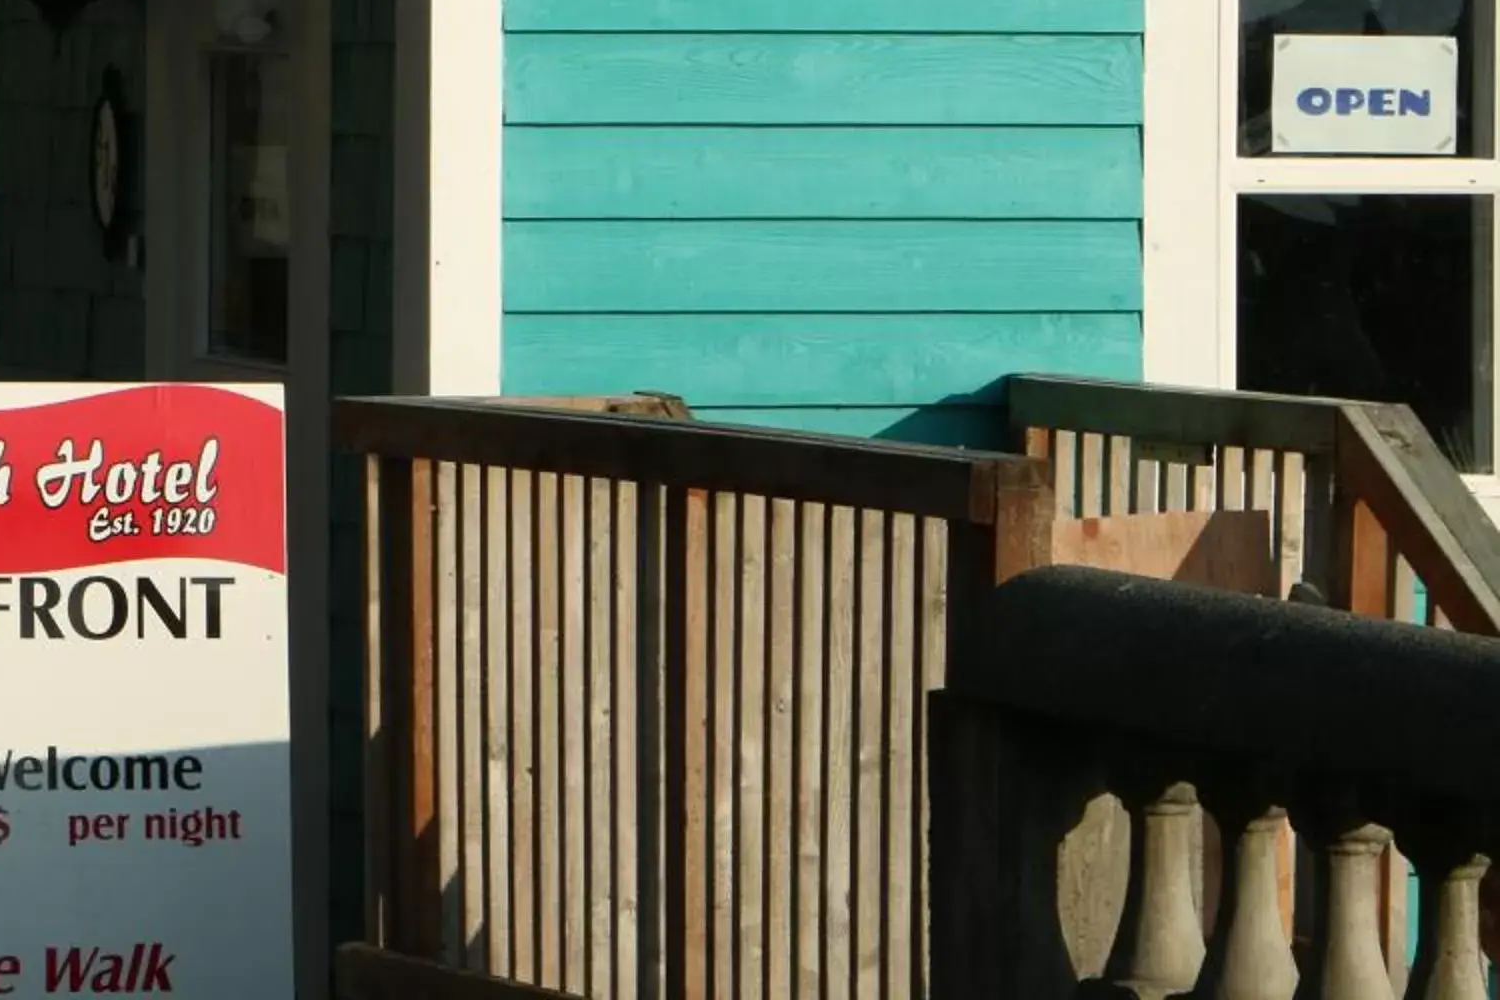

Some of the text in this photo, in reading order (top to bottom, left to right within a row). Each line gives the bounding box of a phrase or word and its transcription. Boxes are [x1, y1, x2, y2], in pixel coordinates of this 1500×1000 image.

[1296, 86, 1431, 117] OPEN
[35, 438, 219, 507] Hotel
[88, 508, 216, 542] Est. 1920
[68, 811, 130, 847] per
[144, 807, 242, 848] night
[44, 943, 177, 995] Walk
